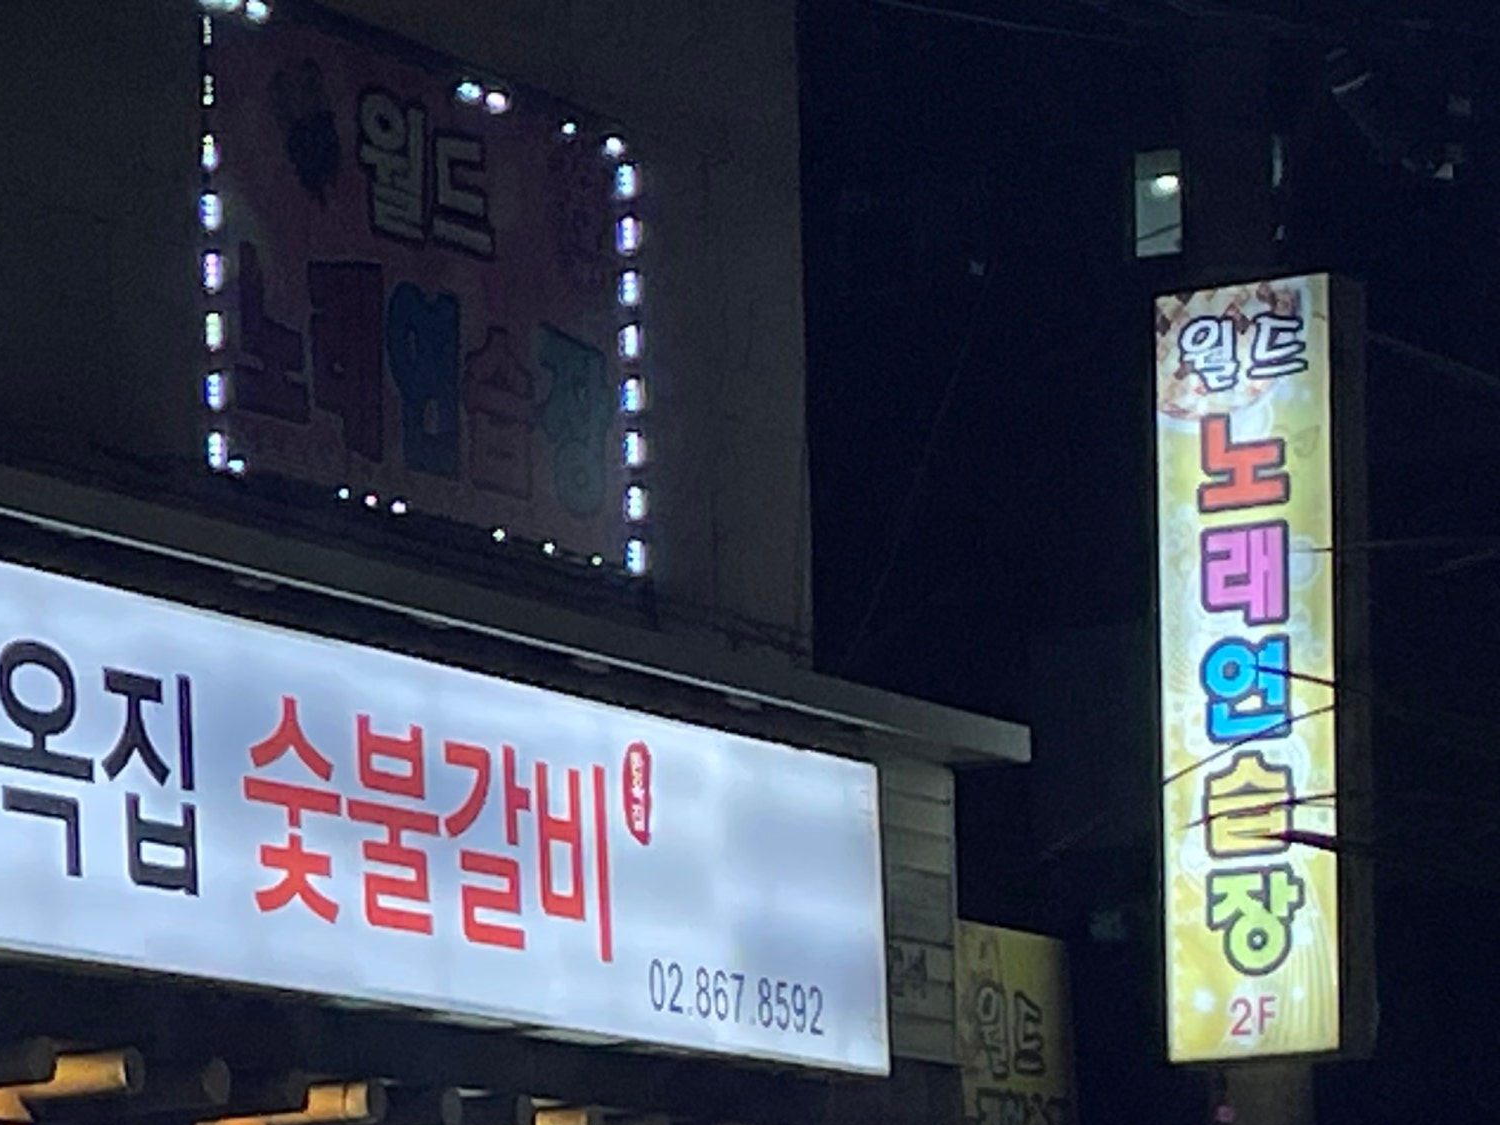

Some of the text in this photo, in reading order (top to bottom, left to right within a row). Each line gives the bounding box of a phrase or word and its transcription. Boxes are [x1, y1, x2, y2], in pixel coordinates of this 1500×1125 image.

[357, 85, 496, 261] 월드
[1177, 312, 1310, 391] 월드
[1195, 411, 1307, 978] 노래연습장
[243, 694, 613, 963] 숯불갈비
[648, 957, 825, 1037] 02.867.8592
[1228, 995, 1278, 1038] 2F
